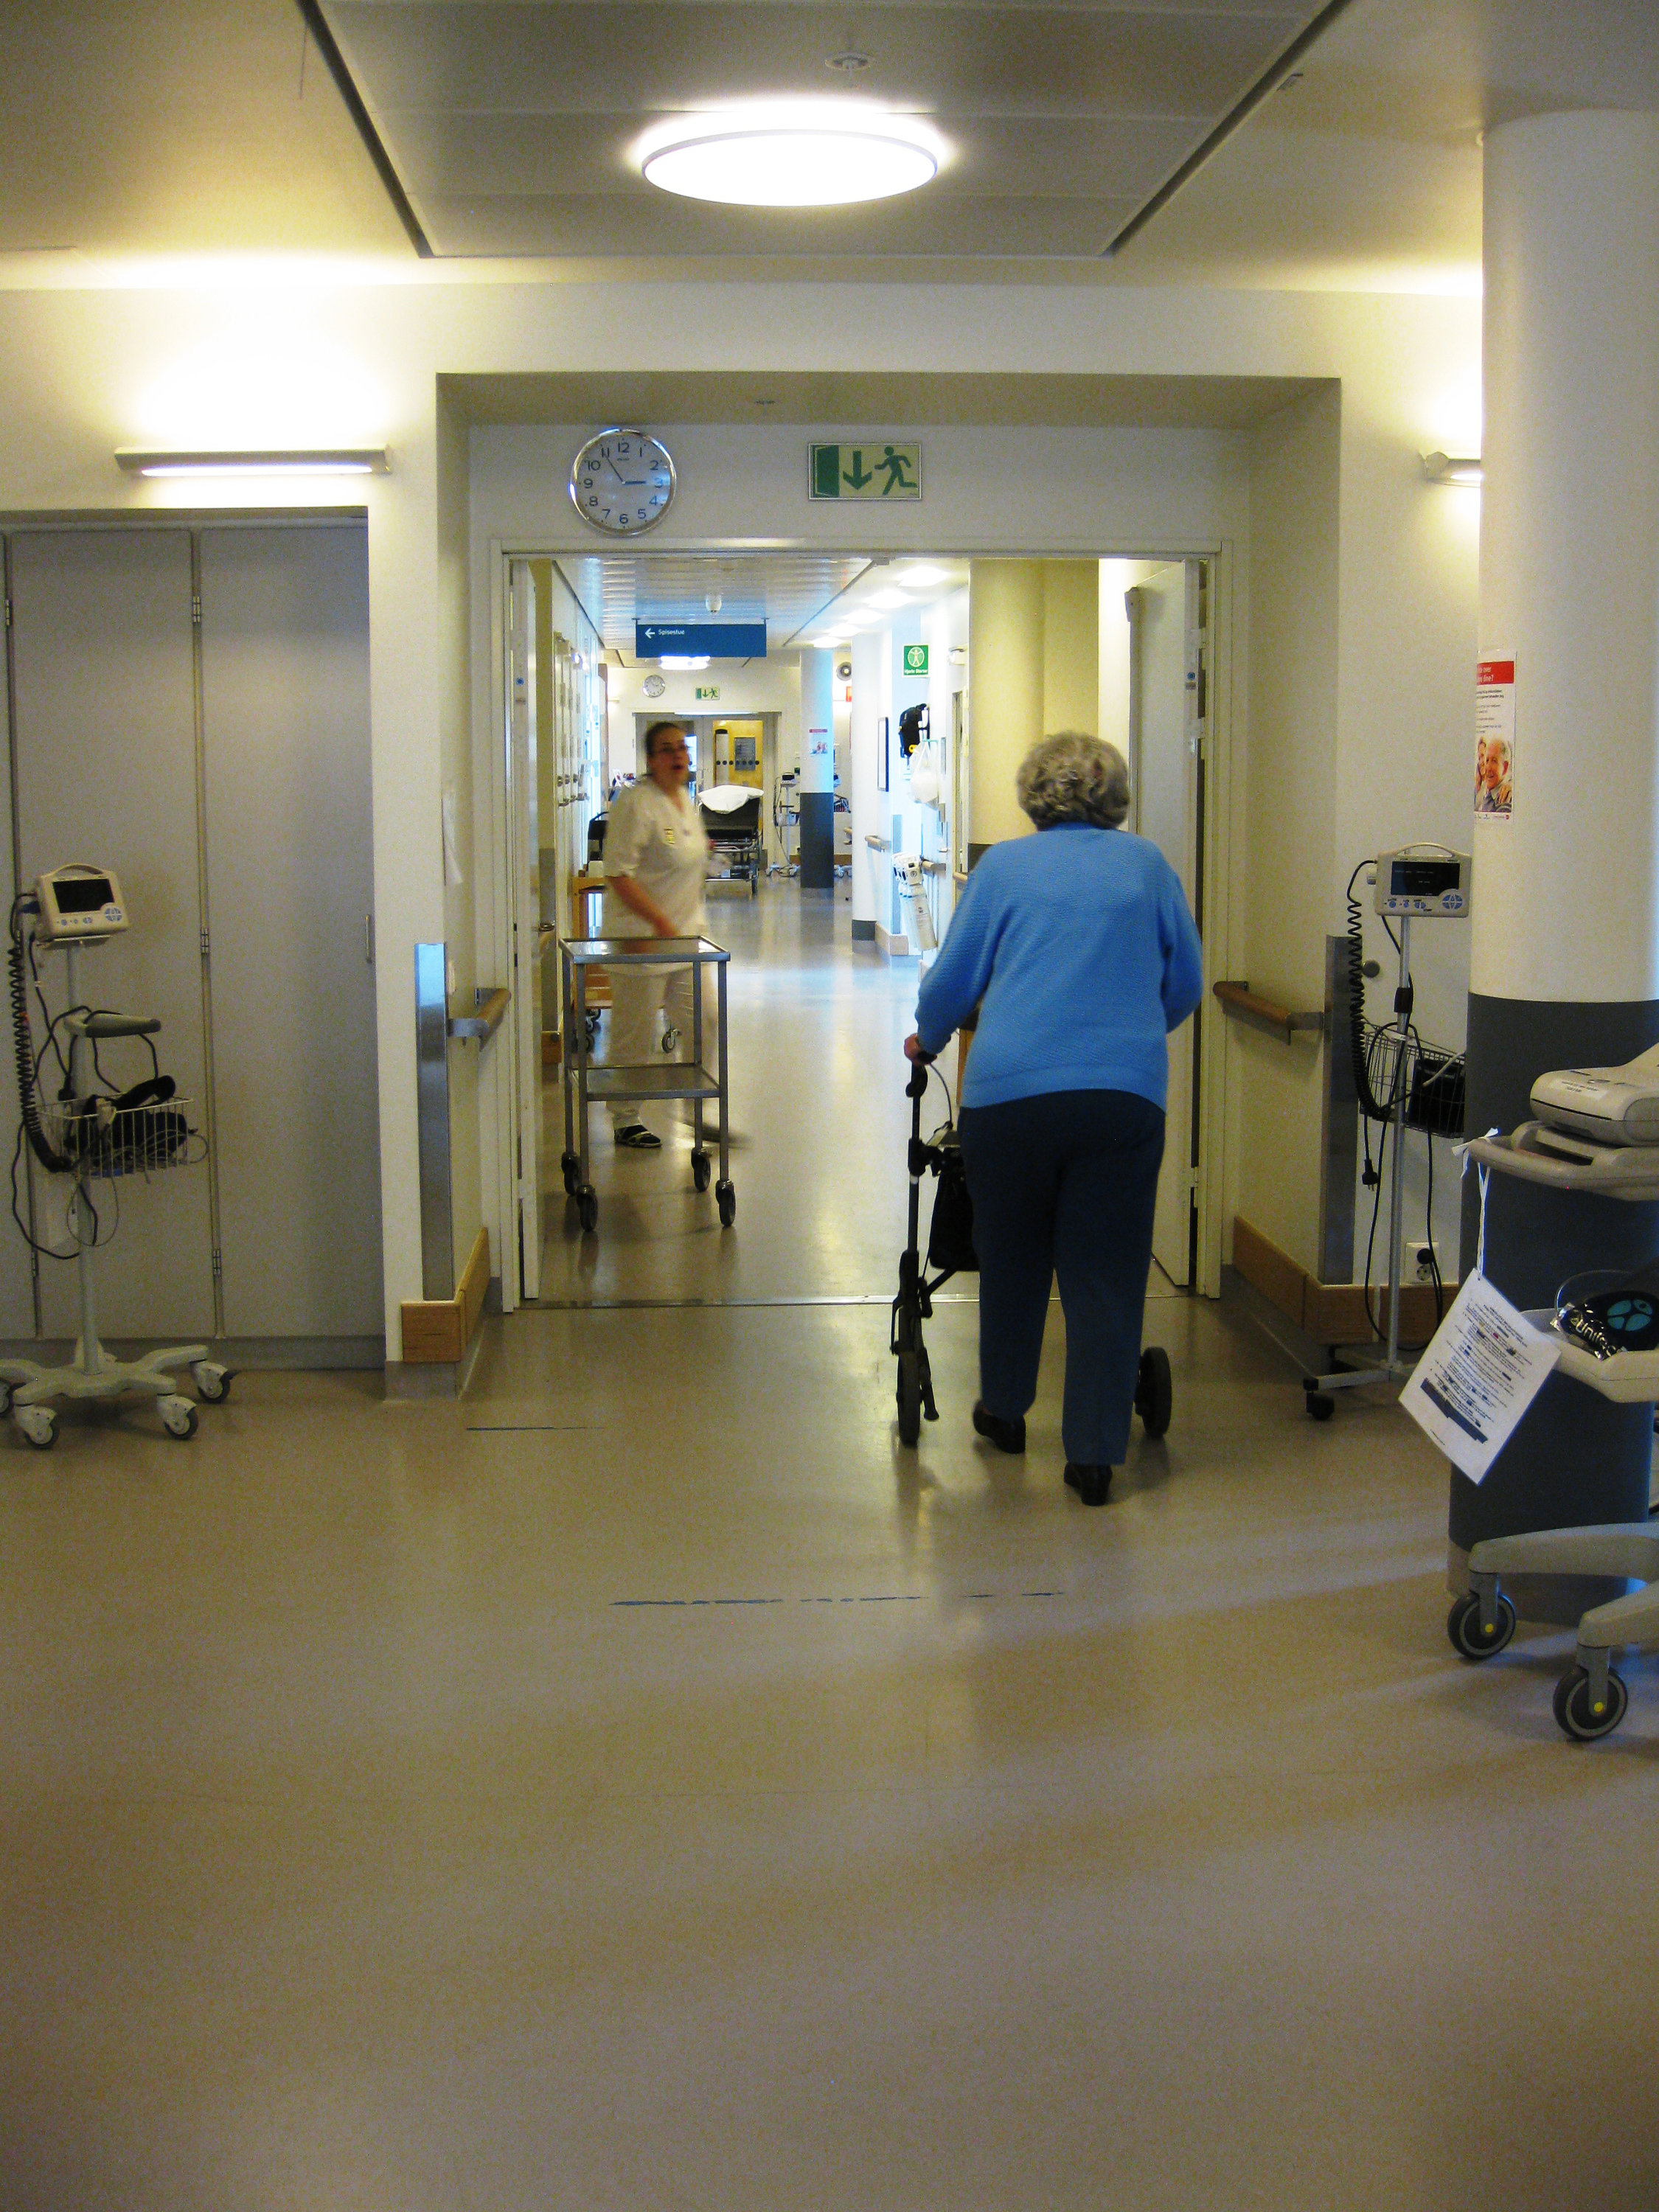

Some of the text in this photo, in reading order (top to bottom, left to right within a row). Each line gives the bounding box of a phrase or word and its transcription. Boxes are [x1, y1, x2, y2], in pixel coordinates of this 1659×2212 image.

[601, 448, 609, 458] 11
[618, 442, 630, 453] 12
[639, 447, 642, 457] 1
[587, 459, 601, 471] 10
[650, 460, 659, 471] 2
[583, 478, 594, 489] 9
[654, 478, 663, 488] 3
[588, 495, 599, 507] 8
[649, 495, 658, 506] 4
[602, 508, 611, 519] 7
[619, 513, 629, 524] 6
[637, 508, 647, 519] 5
